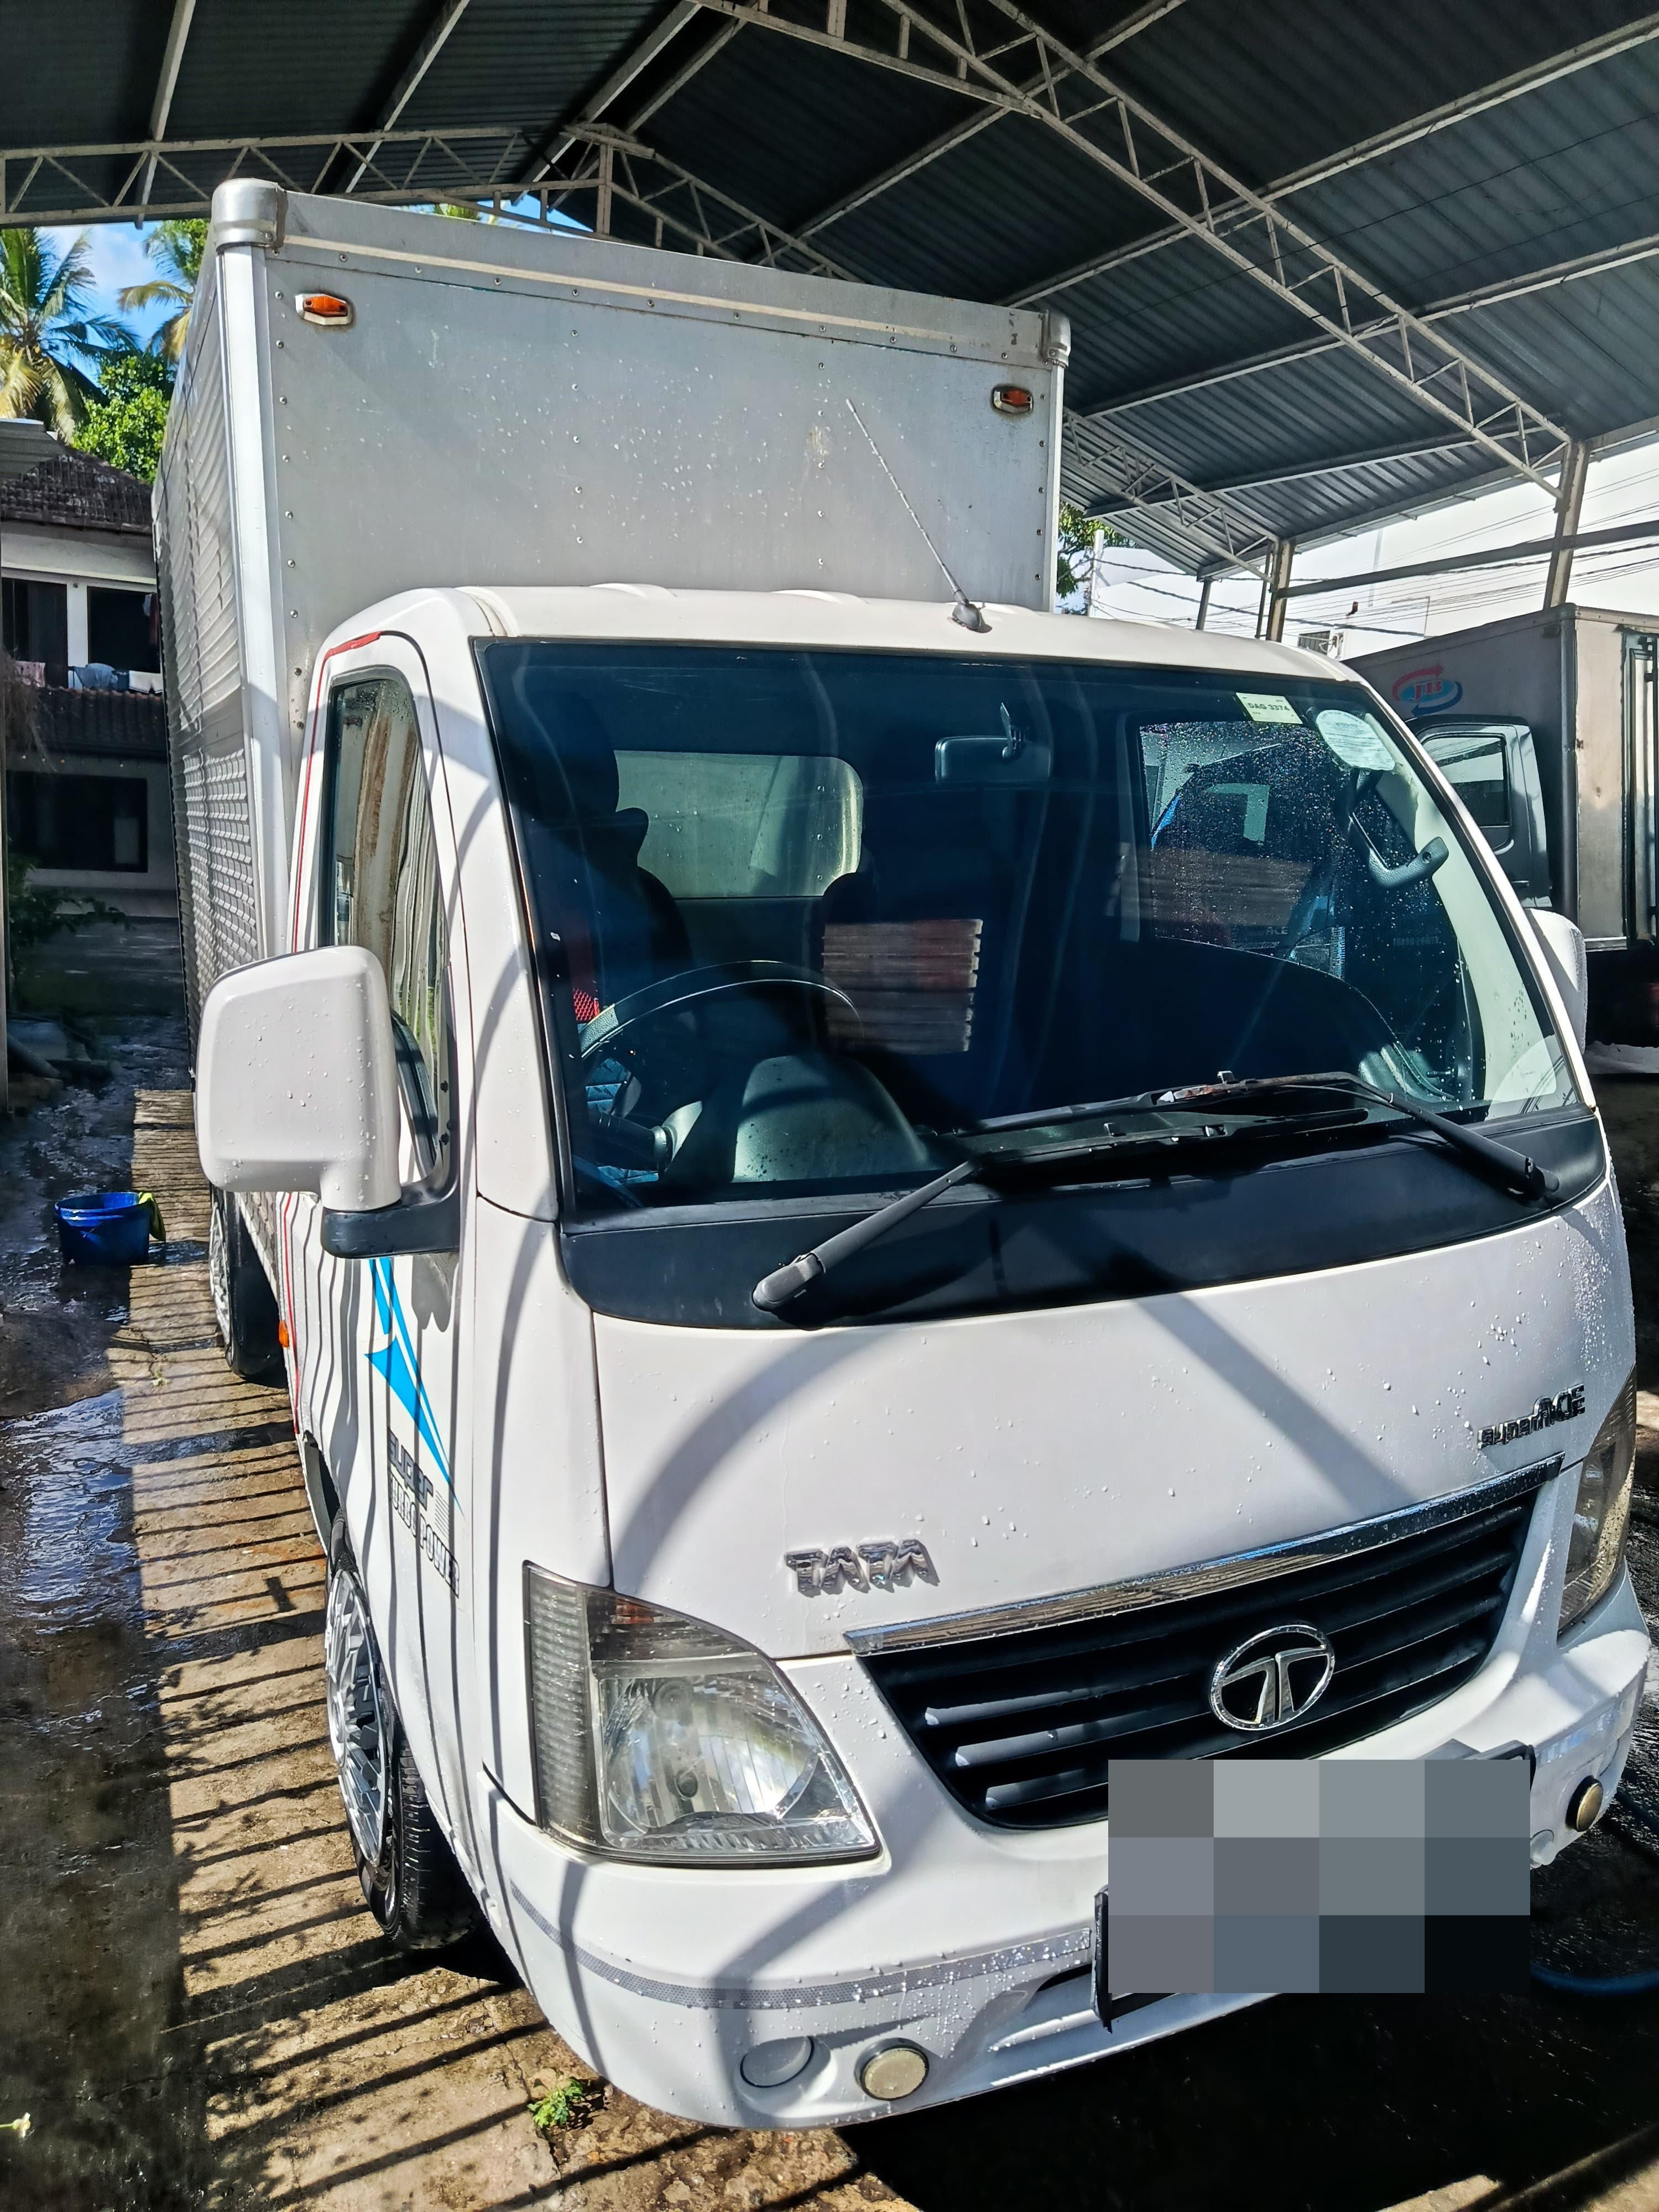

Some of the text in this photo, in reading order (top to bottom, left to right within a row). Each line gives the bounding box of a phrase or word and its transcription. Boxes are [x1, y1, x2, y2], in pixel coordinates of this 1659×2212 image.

[1409, 681, 1443, 702] JB
[419, 1512, 460, 1599] POWER
[784, 1539, 935, 1594] TATA
